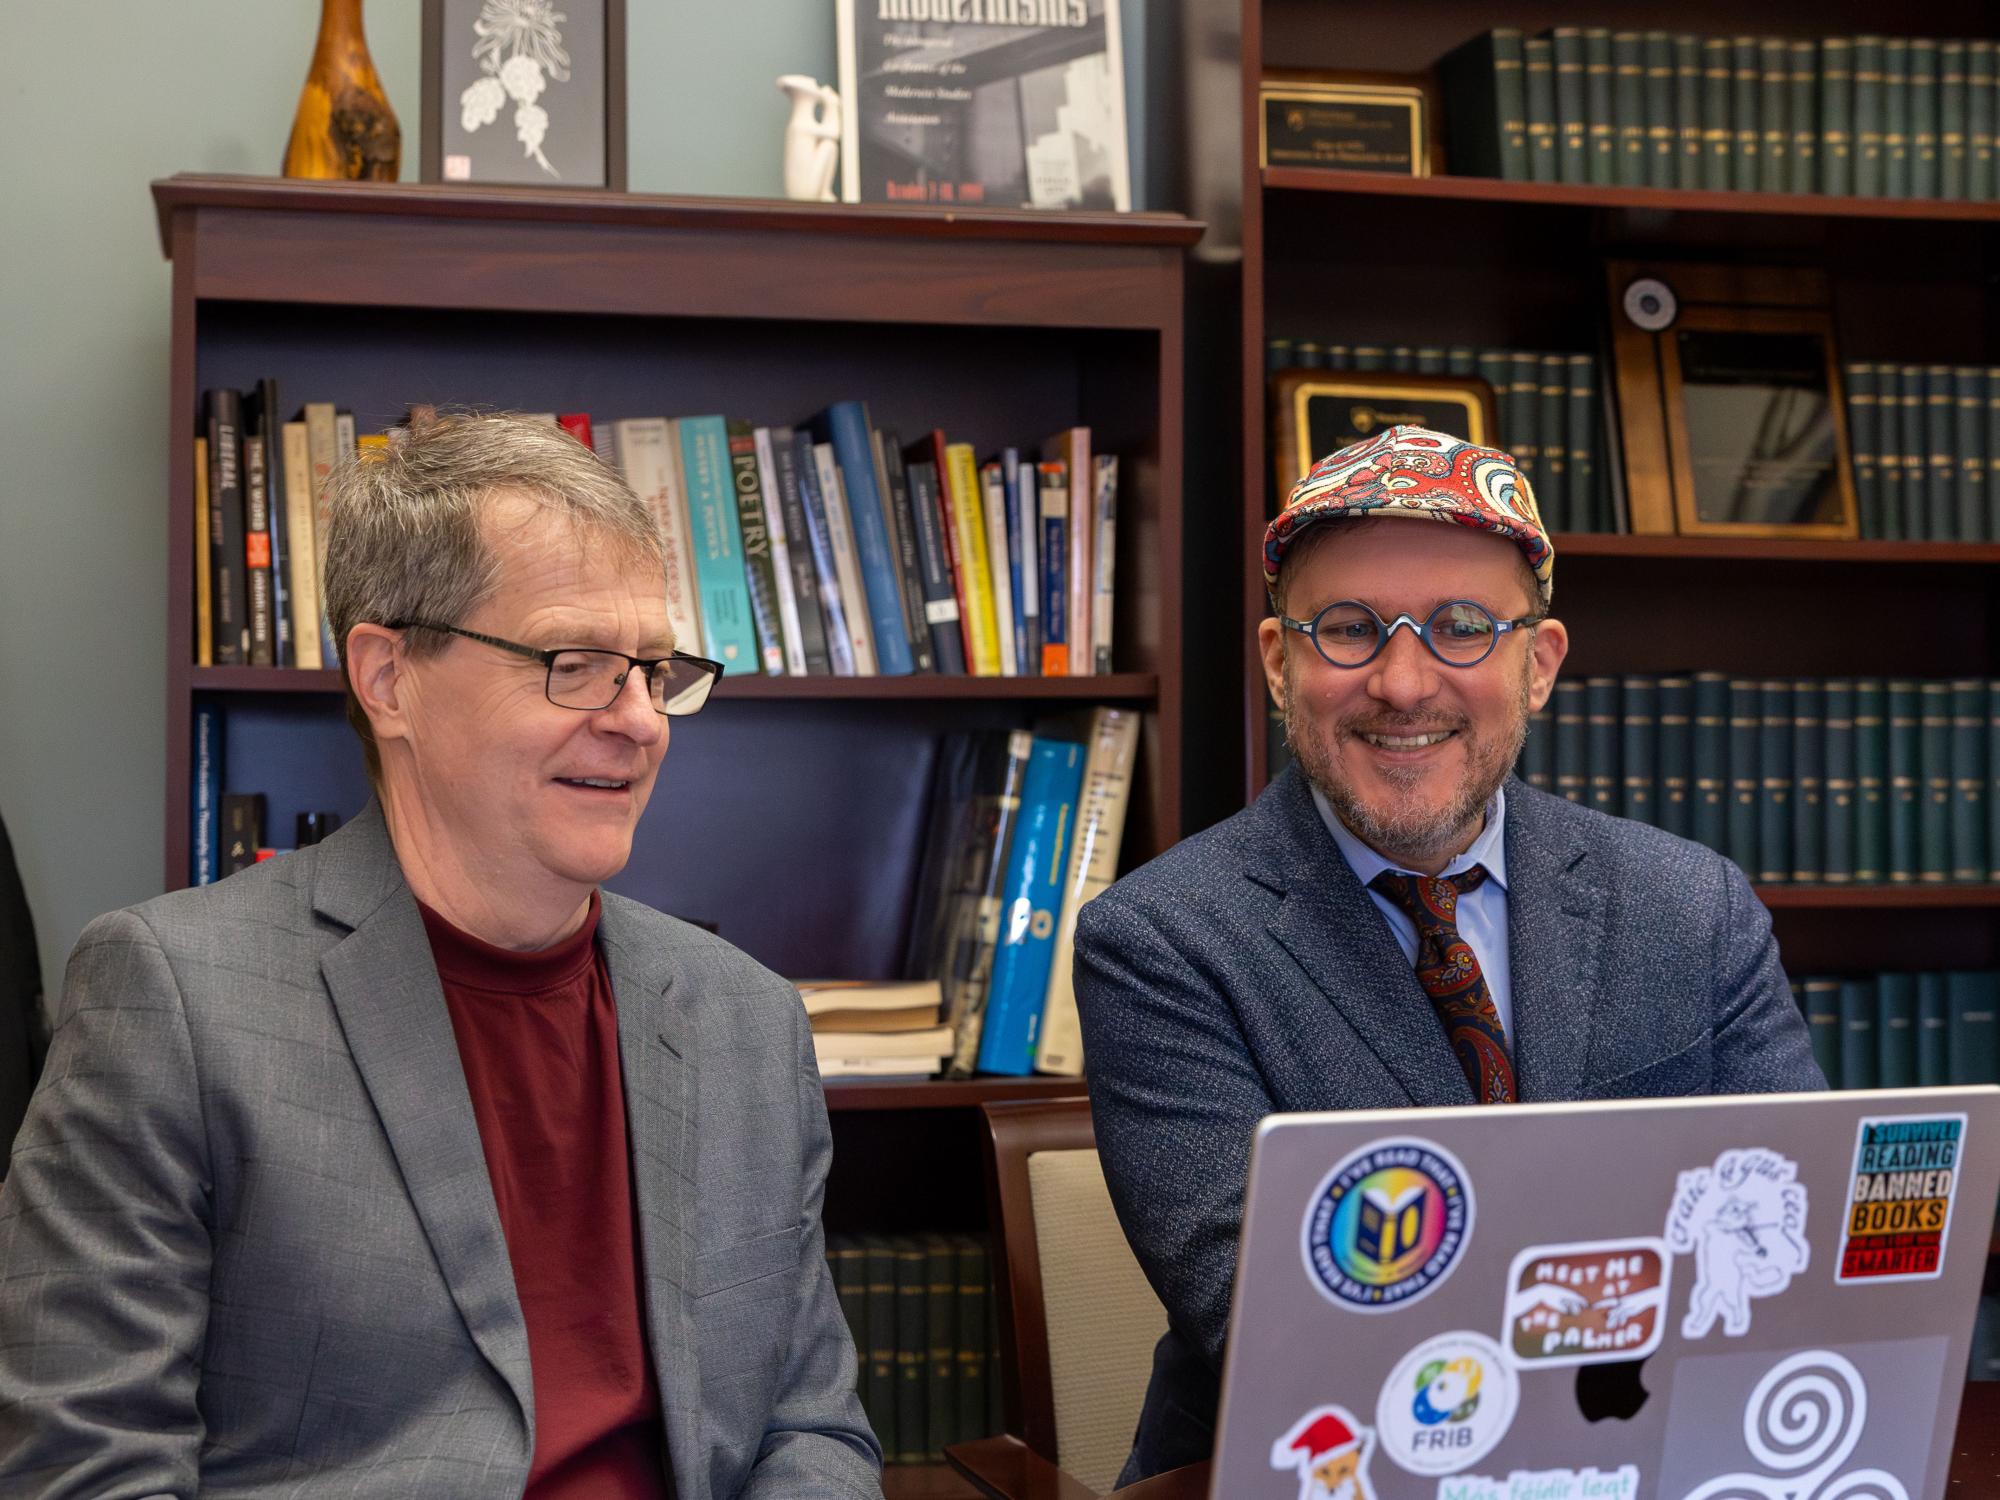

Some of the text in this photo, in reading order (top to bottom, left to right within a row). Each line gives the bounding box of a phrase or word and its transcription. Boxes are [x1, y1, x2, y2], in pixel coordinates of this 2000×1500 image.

[219, 424, 236, 490] LIBERAL
[251, 442, 264, 469] THE
[251, 473, 263, 485] N
[252, 488, 265, 531] WORD
[733, 455, 768, 559] POETRY
[1875, 1120, 1961, 1143] SURVIVED
[1373, 1150, 1420, 1166] READ
[1420, 1154, 1457, 1187] THAT
[1863, 1142, 1954, 1169] READING
[1855, 1170, 1952, 1202] BANNED
[1312, 1196, 1335, 1244] THAT
[1854, 1201, 1943, 1232] BOOKS
[1314, 1246, 1342, 1287] READ
[1424, 1231, 1459, 1276] READ
[1844, 1250, 1937, 1274] SMARTER
[1384, 1272, 1427, 1300] THAT
[1535, 1255, 1643, 1286] MEET ME
[1603, 1279, 1631, 1297] AT
[1520, 1310, 1560, 1332] THE
[1541, 1323, 1642, 1354] PALMER
[1411, 1427, 1473, 1452] FRIB
